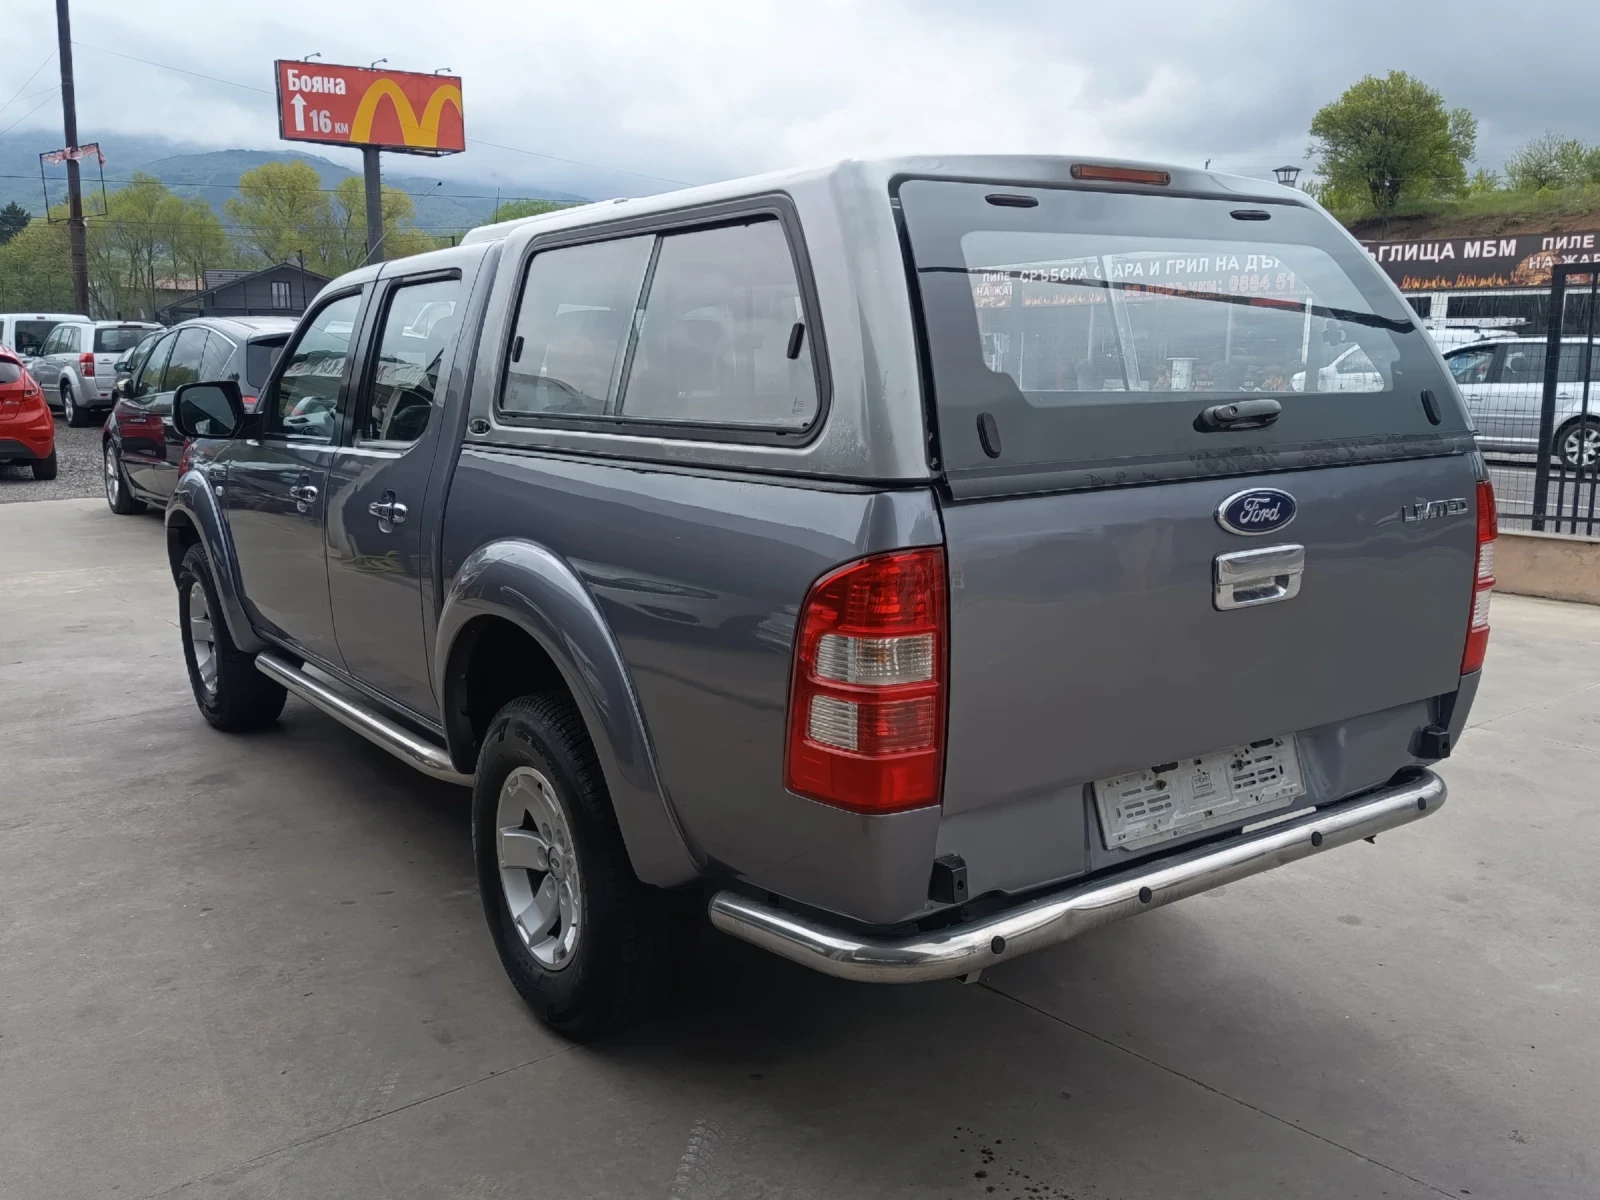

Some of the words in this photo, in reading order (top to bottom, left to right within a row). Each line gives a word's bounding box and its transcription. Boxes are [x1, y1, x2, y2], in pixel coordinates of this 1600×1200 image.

[287, 68, 346, 95] Бояна
[309, 109, 332, 133] 16
[1463, 239, 1517, 259] МБМ
[1542, 234, 1595, 251] ПИЛЕ
[1020, 264, 1089, 284] СРЪБСКА
[1149, 260, 1160, 276] И
[1165, 257, 1210, 275] ГРИЛ
[1215, 255, 1240, 272] НА
[1529, 255, 1554, 270] НА
[1228, 273, 1270, 292] 0884
[1239, 497, 1282, 525] Ford
[1401, 497, 1469, 523] LIMITED
